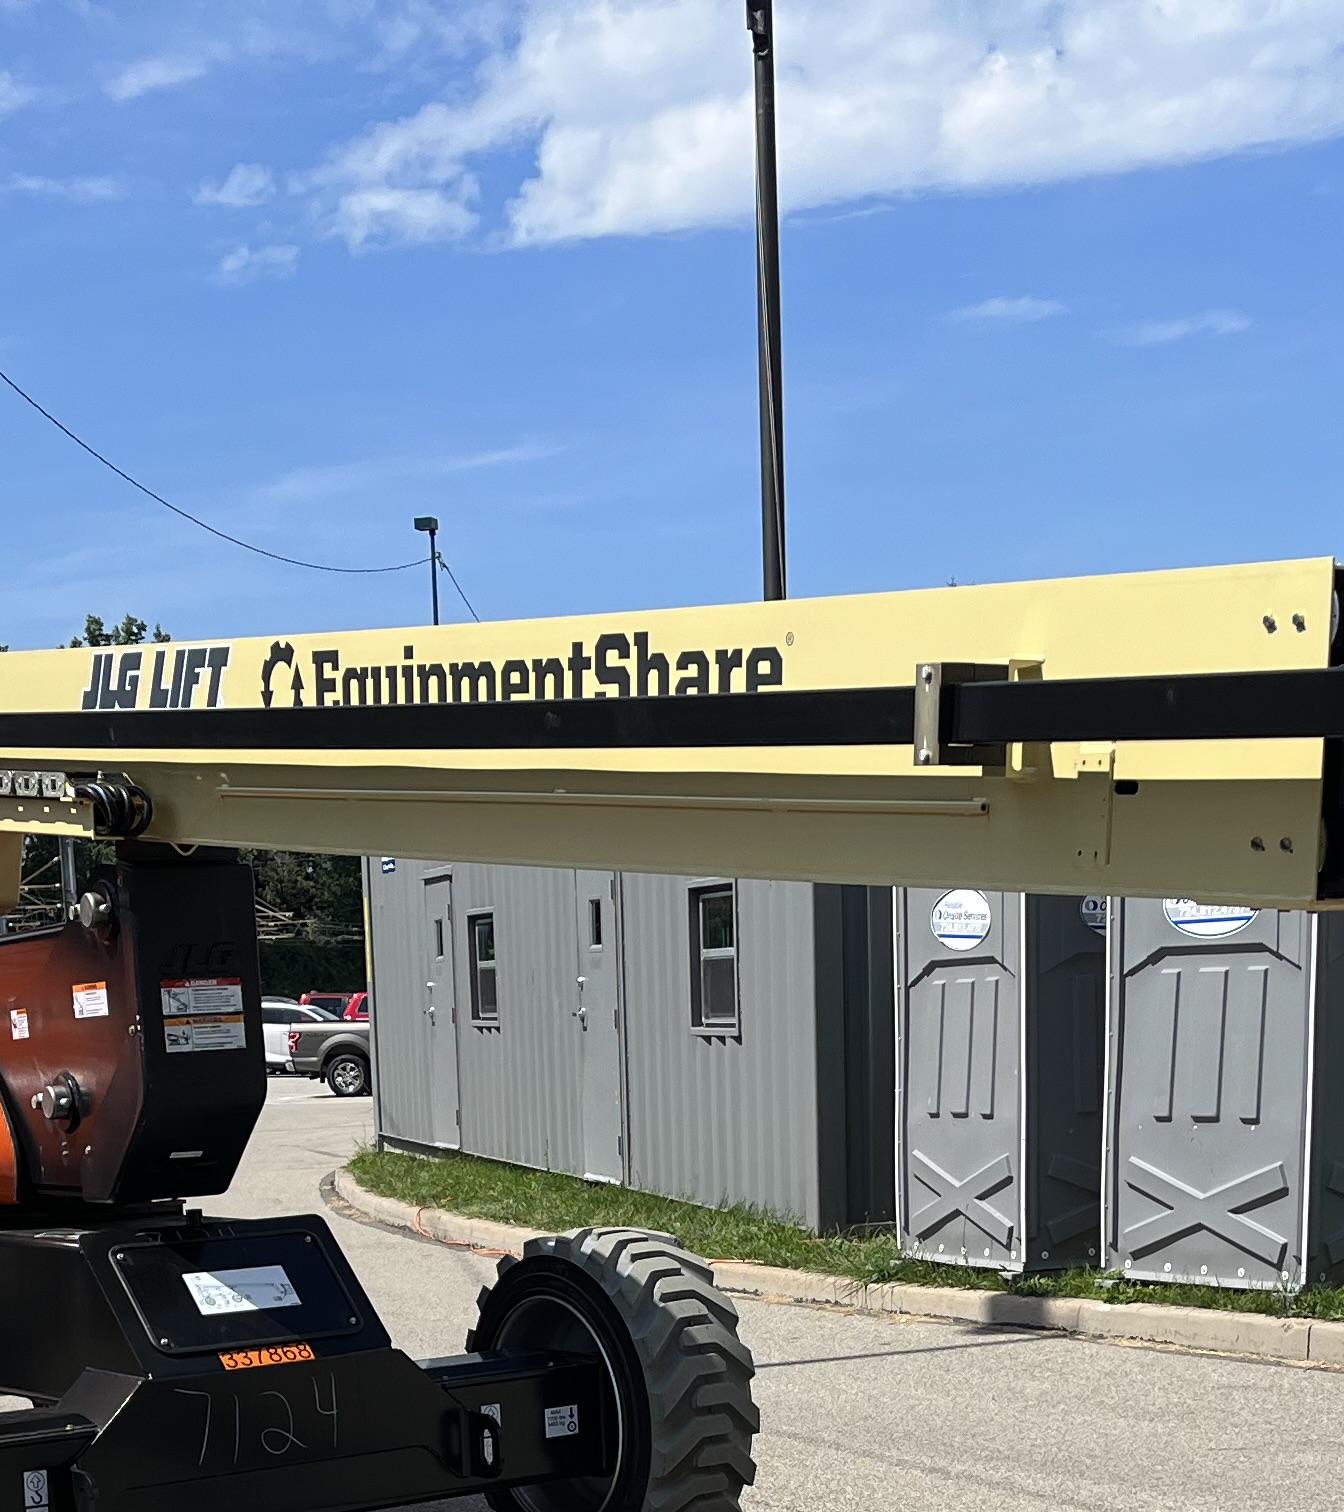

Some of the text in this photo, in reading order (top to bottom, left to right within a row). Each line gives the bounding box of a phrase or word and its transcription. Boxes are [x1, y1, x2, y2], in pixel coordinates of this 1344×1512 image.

[82, 646, 230, 710] JLG LIFT
[225, 1343, 312, 1369] 337868
[173, 1371, 340, 1466] 7124
